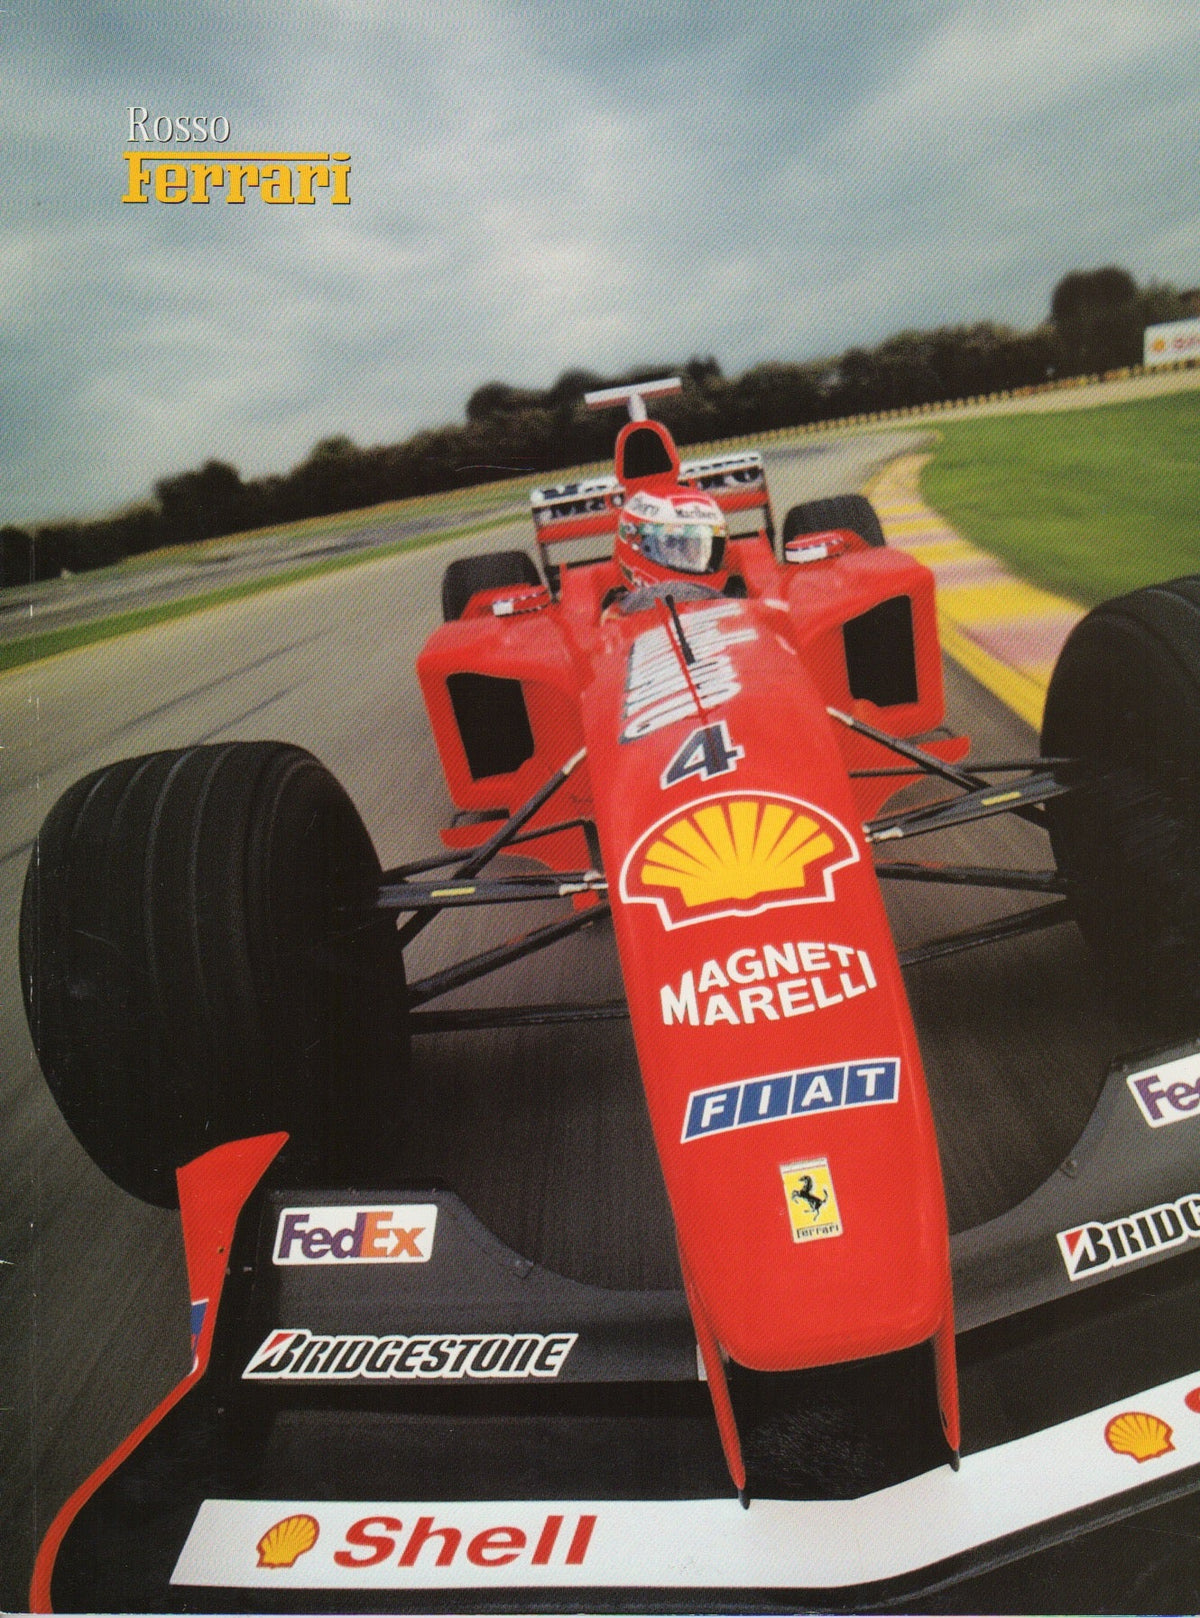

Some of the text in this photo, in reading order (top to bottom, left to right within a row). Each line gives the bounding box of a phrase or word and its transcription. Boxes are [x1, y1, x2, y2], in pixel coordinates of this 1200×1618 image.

[662, 722, 744, 789] 4
[660, 971, 877, 1025] MARELLI
[701, 1067, 885, 1128] FIAT
[1134, 1075, 1200, 1120] Fe
[278, 1211, 425, 1259] FedEx
[796, 1225, 839, 1239] Ferrari
[249, 1331, 570, 1374] BRIDGESTONE
[333, 1514, 598, 1567] Shell
